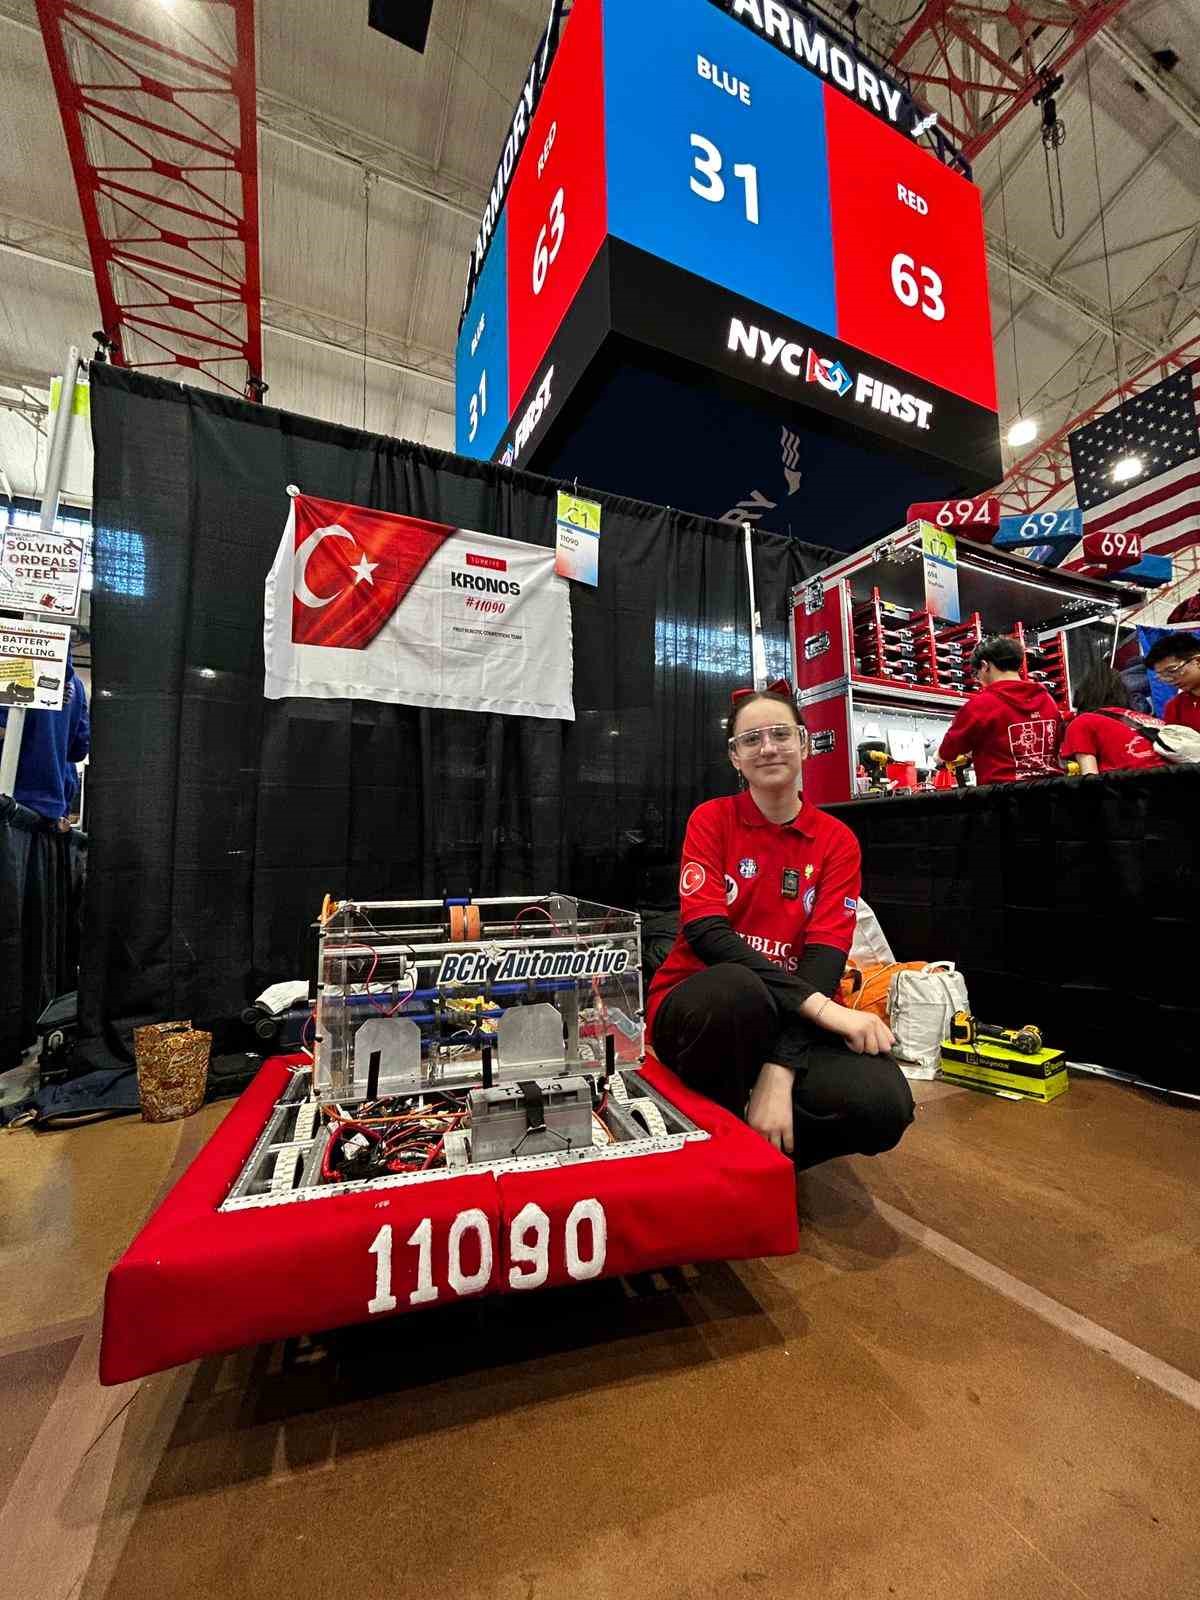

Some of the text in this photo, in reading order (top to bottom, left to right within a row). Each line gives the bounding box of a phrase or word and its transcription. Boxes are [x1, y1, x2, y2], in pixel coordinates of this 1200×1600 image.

[735, 0, 901, 121] ARMORY
[696, 54, 751, 106] BLUE
[538, 121, 557, 179] RED
[475, 61, 537, 275] ARMORY
[690, 133, 760, 225] 31
[897, 183, 929, 216] RED
[532, 187, 565, 295] 63
[890, 252, 946, 321] 63
[727, 317, 804, 376] NYC
[469, 368, 487, 442] 31
[514, 365, 555, 460] FIRST
[567, 507, 588, 528] C1
[936, 500, 991, 527] 694
[1019, 512, 1075, 539] 694
[6, 540, 73, 555] SOLVING
[560, 535, 579, 546] 11090
[1101, 532, 1140, 557] 694
[9, 554, 77, 568] ORDEALS
[16, 568, 60, 580] STEEL
[451, 571, 521, 596] KRONOS
[465, 596, 505, 614] #11090
[0, 645, 55, 657] ECYCLING
[3, 635, 50, 646] BATTERY
[438, 947, 629, 984] BCR Automotive
[368, 1198, 607, 1313] 11090
